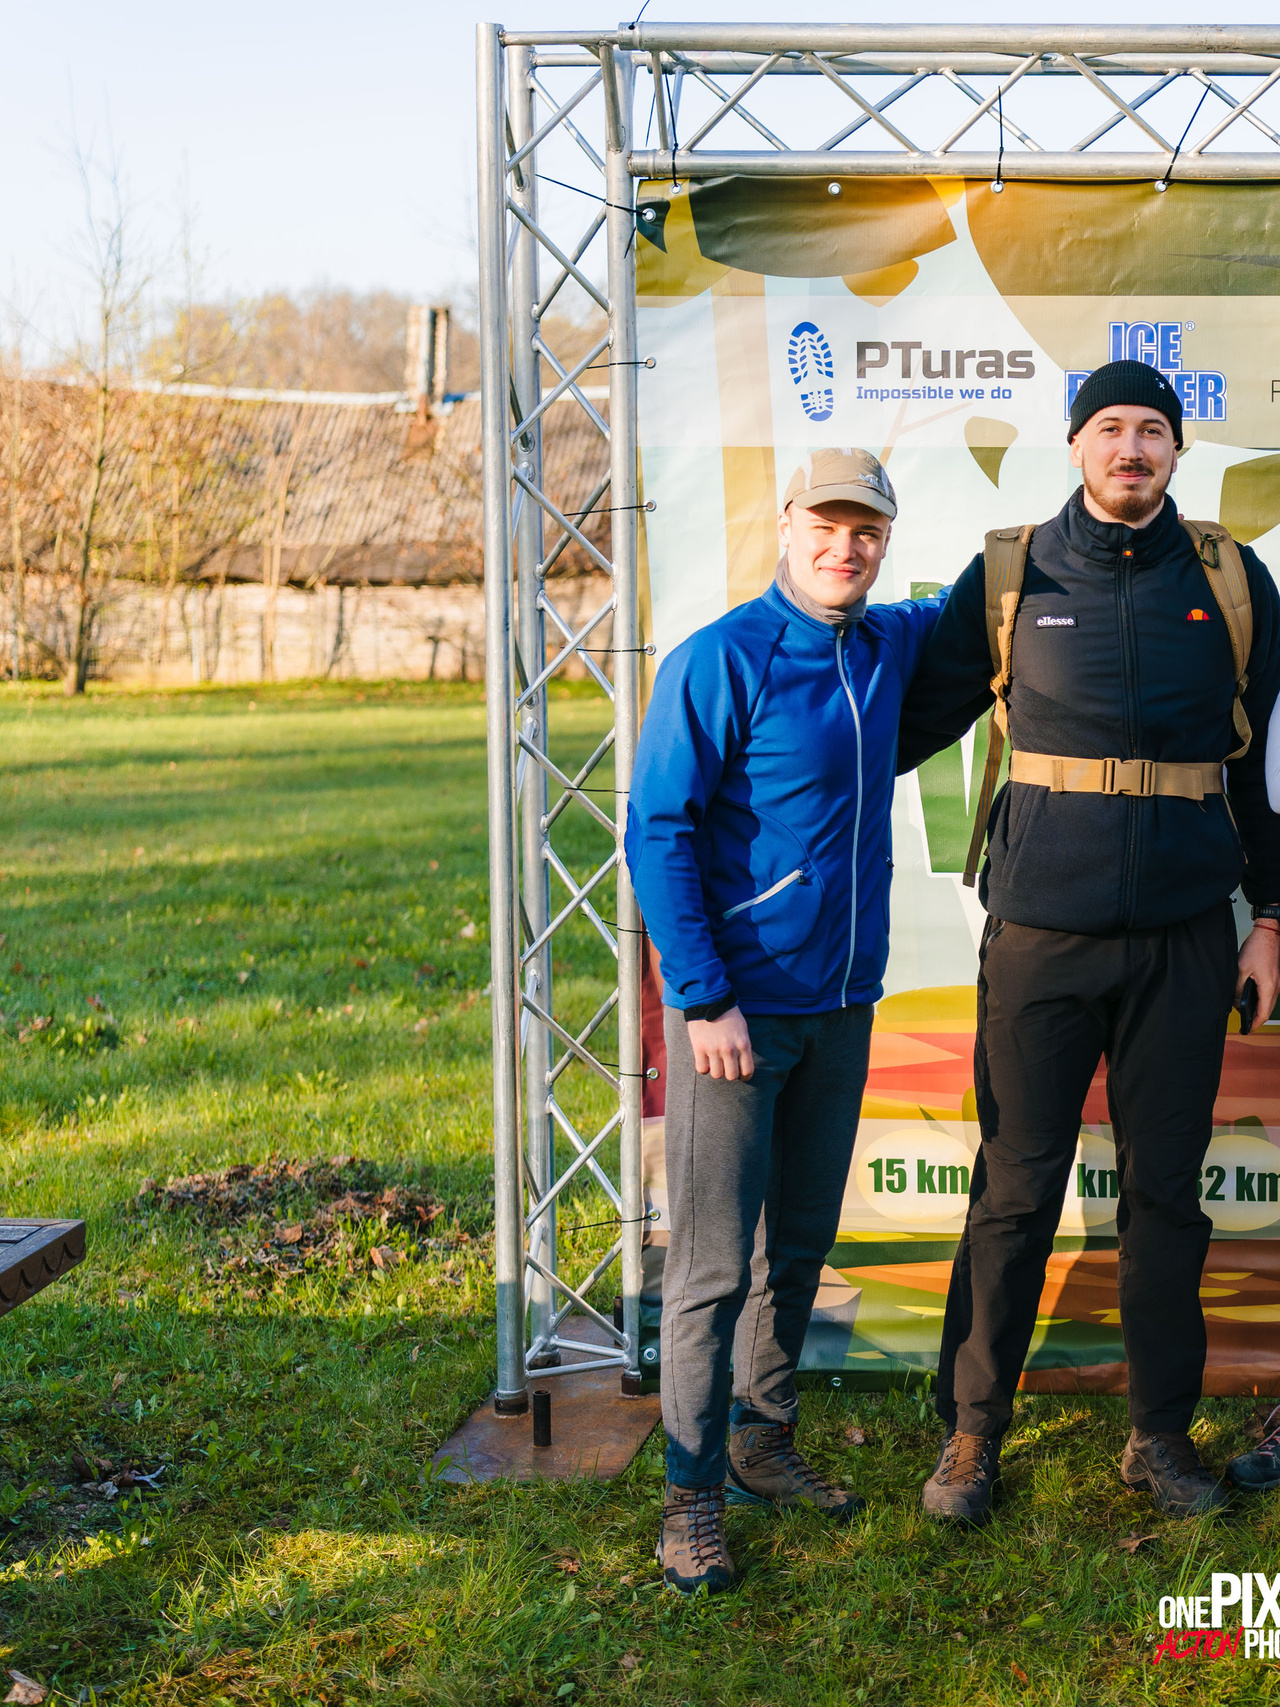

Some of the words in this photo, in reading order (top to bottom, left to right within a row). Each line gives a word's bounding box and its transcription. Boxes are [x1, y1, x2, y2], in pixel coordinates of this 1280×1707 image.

[857, 341, 1036, 379] PTuras
[1109, 321, 1183, 371] ICE
[856, 386, 954, 402] Impossible
[959, 388, 985, 399] we
[990, 386, 1012, 399] do
[1065, 370, 1228, 421] PER
[1037, 616, 1075, 626] ellesse
[868, 1158, 907, 1193] 15
[917, 1159, 970, 1194] km
[1197, 1165, 1226, 1201] 2
